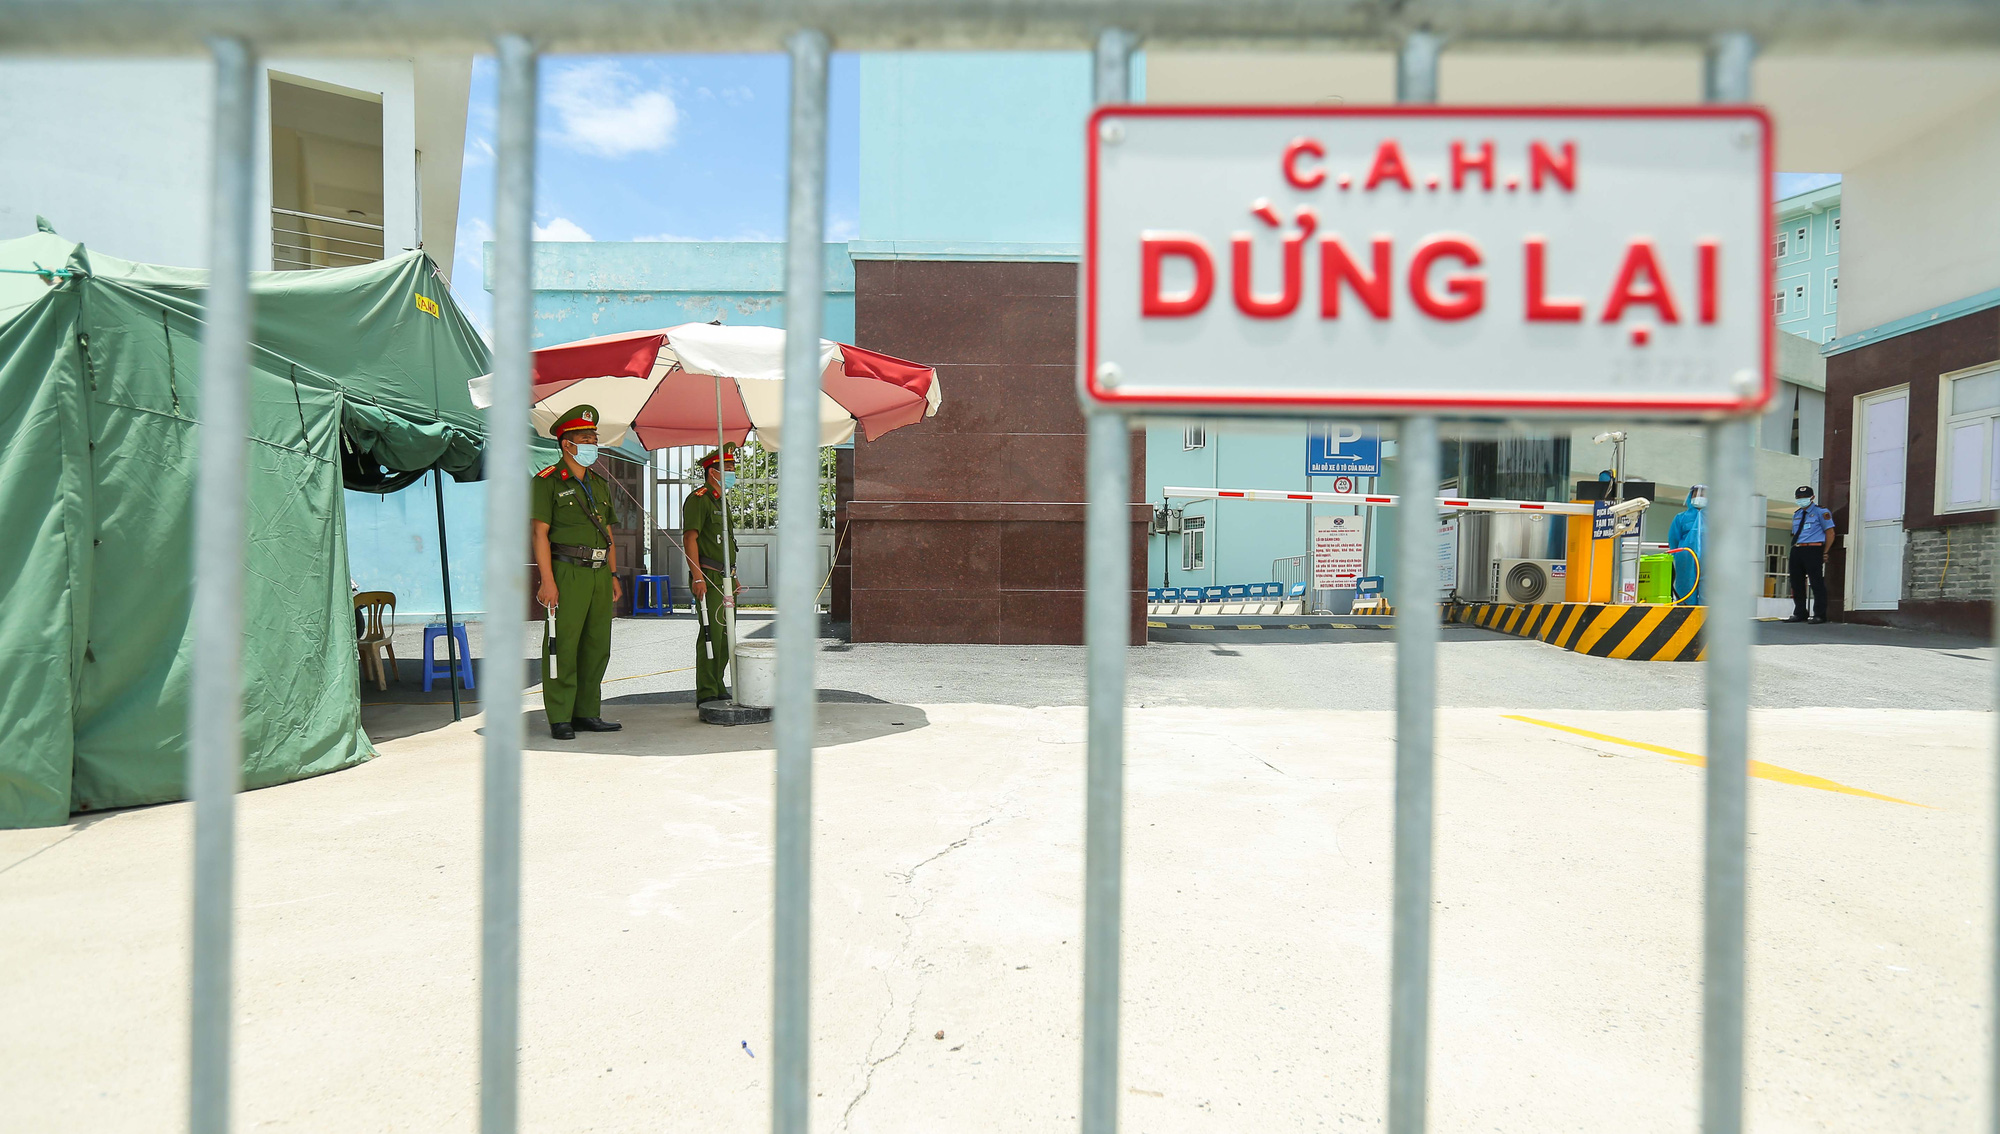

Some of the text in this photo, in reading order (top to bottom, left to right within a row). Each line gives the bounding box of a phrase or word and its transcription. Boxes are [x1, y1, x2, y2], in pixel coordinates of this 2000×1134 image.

[1282, 138, 1577, 193] C.A.H.N
[1140, 198, 1719, 345] DỪNG LẠI
[1331, 424, 1362, 454] P
[1341, 463, 1347, 471] TÔ
[1348, 462, 1357, 471] CỦA
[1358, 464, 1375, 472] KHÁCH
